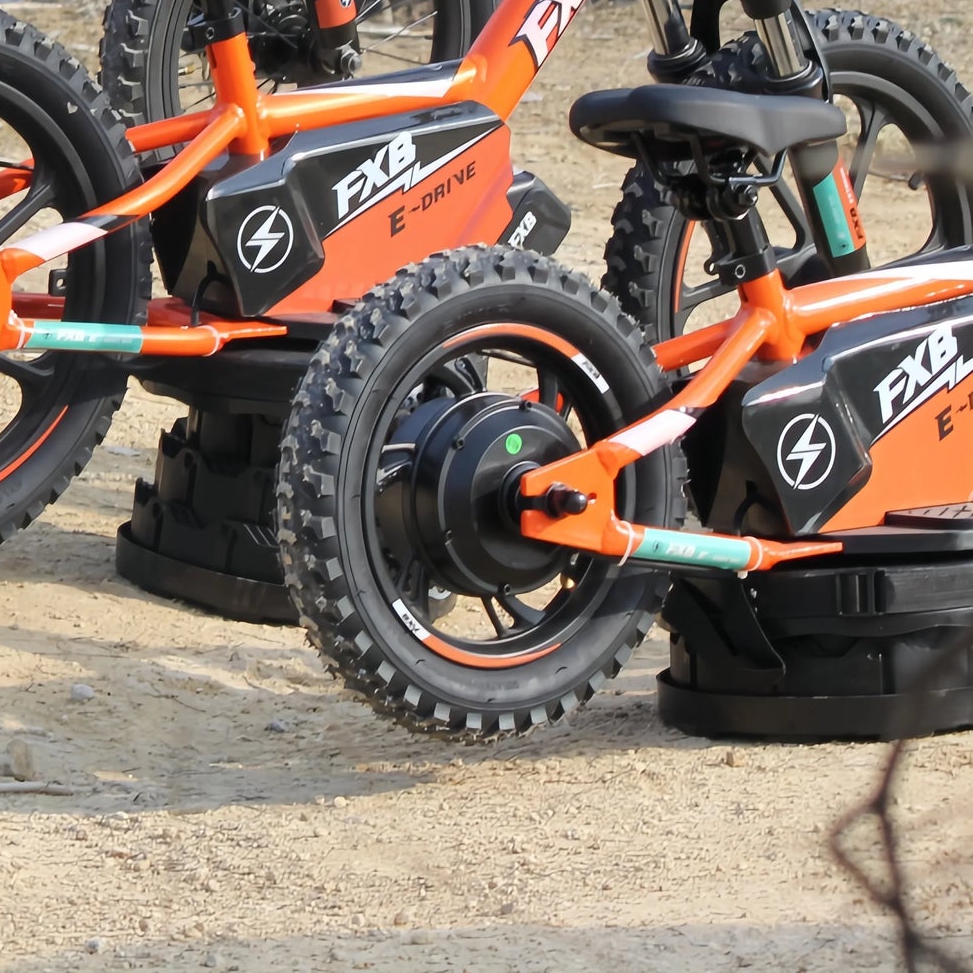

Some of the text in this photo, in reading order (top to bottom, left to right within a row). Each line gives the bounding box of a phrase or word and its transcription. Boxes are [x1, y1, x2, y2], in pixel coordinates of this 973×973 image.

[331, 130, 417, 220] FXB
[507, 210, 537, 250] FXB
[872, 323, 959, 425] FXB
